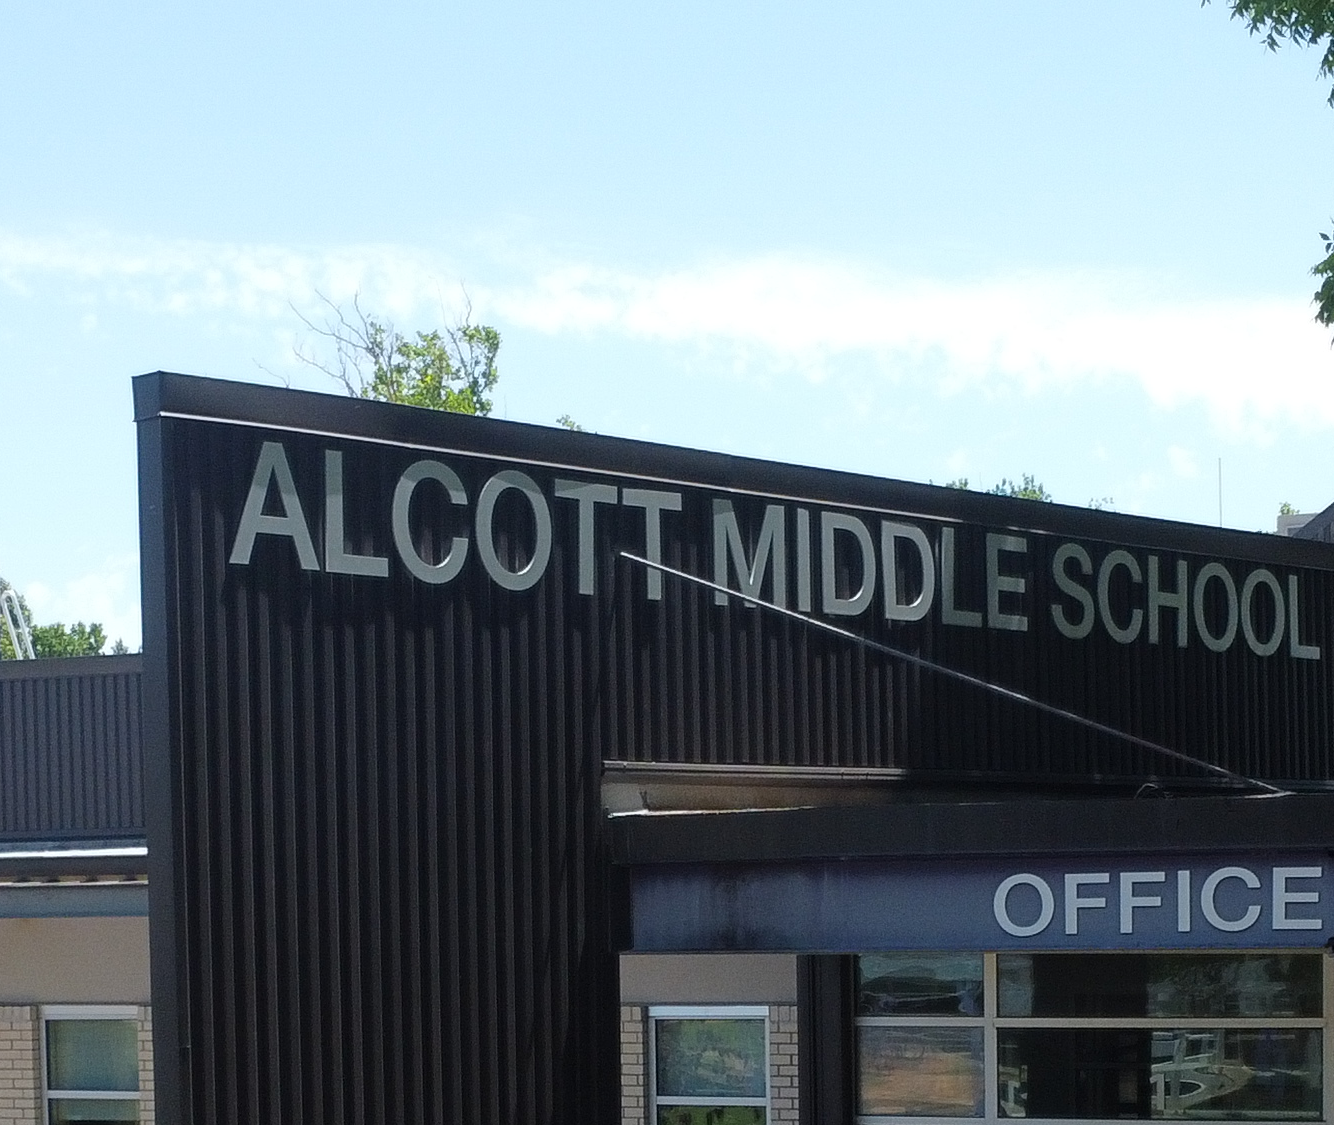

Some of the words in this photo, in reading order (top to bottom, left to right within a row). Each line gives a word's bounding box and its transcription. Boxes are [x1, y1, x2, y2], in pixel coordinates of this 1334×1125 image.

[229, 441, 682, 601] ALCOTT
[712, 498, 1028, 632] MIDDLE
[1051, 542, 1321, 660] SCHOOL
[993, 866, 1323, 937] OFFICE
